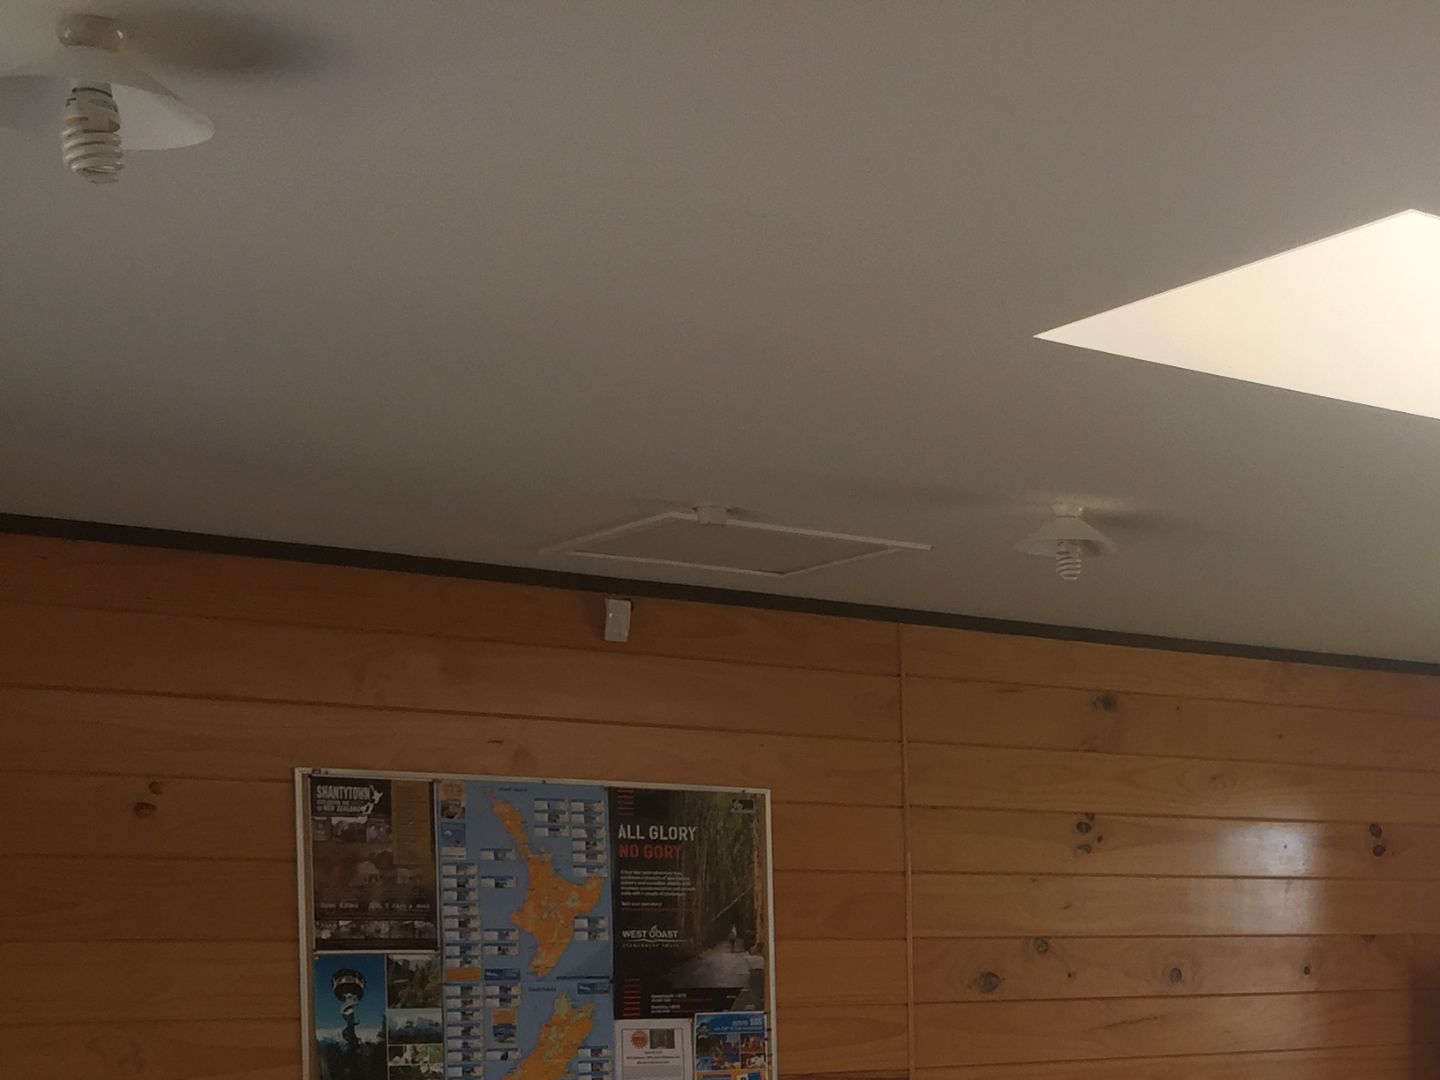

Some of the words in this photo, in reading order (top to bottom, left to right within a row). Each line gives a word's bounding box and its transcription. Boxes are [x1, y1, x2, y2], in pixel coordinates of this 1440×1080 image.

[316, 785, 371, 800] SHANTYTOWN
[618, 823, 646, 840] ALL
[649, 824, 697, 841] GLORY
[618, 843, 639, 858] NO
[643, 844, 682, 860] GORY
[622, 929, 648, 938] WEST
[648, 928, 679, 939] COAST
